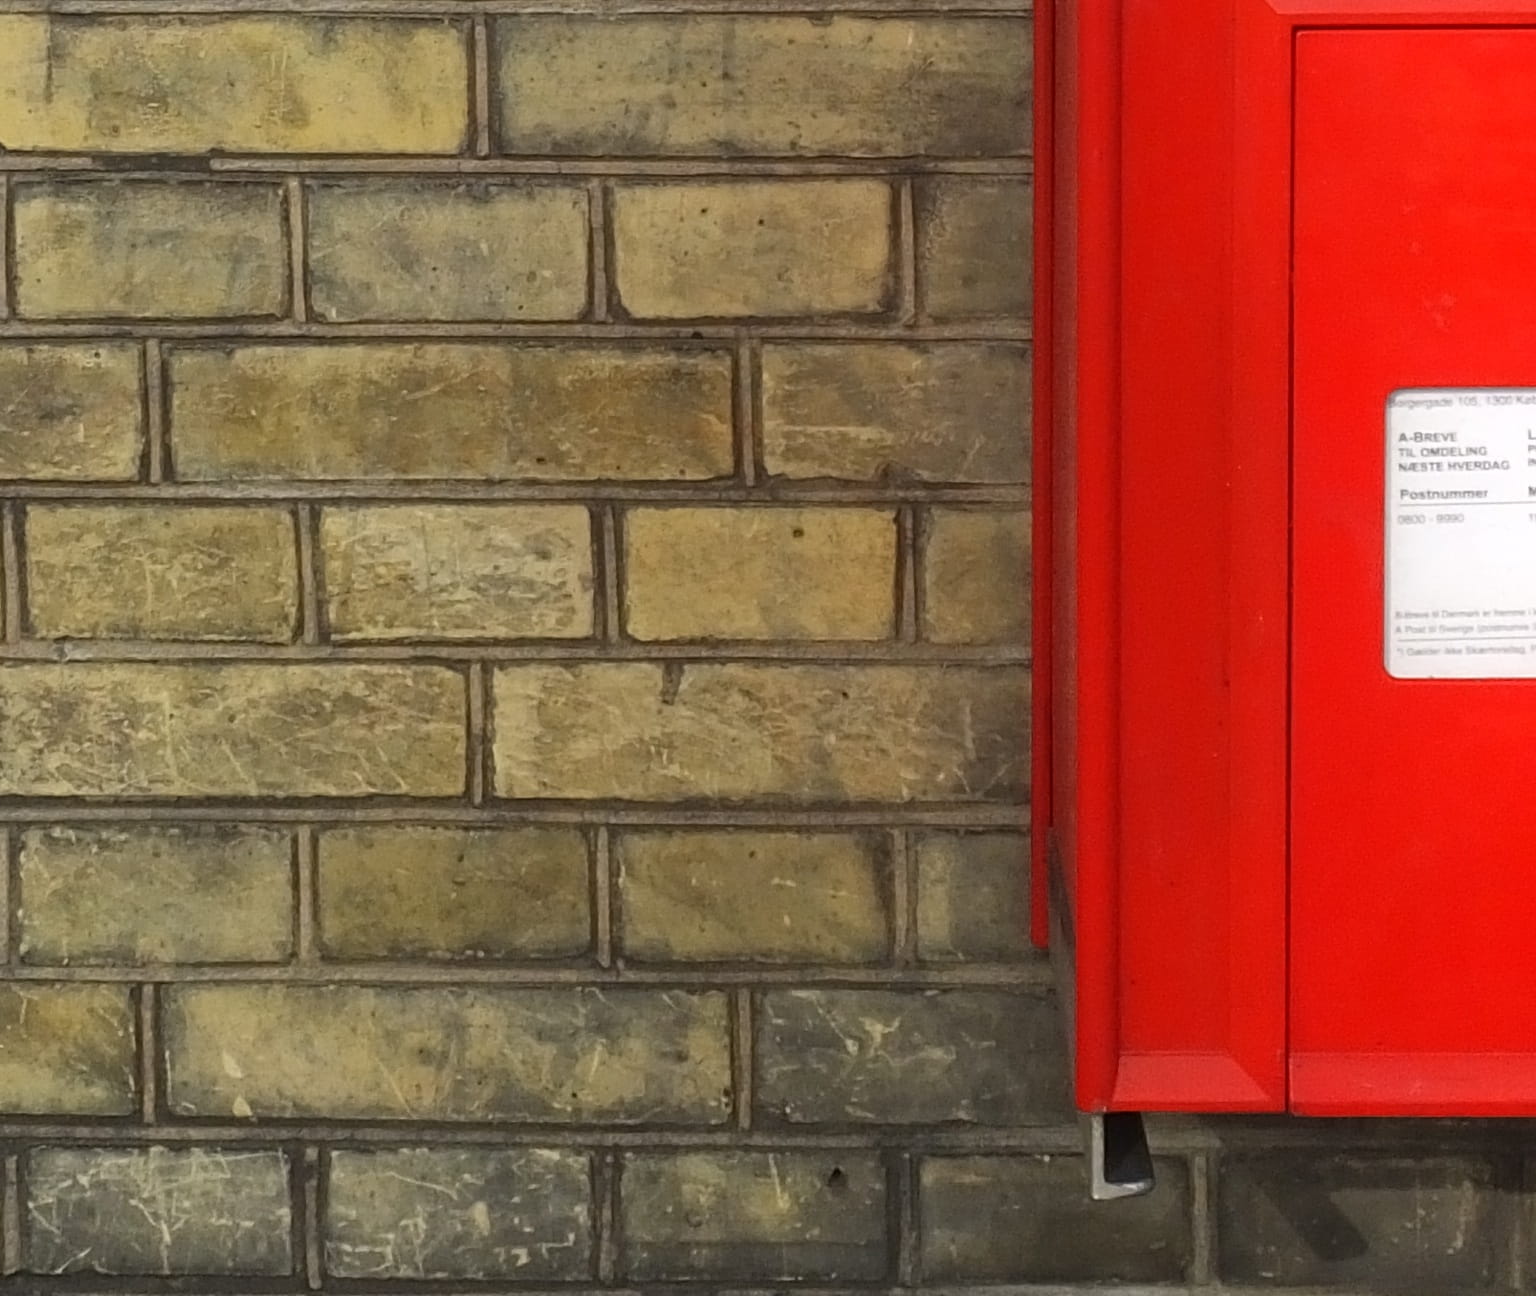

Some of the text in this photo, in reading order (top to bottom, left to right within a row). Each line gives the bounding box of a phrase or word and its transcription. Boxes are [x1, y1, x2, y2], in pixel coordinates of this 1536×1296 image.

[1398, 431, 1457, 443] A-BREVE
[1398, 446, 1488, 458] TIL OMDELING
[1398, 460, 1511, 473] NÆSTE HVERDAG
[1399, 488, 1489, 500] Postnummer
